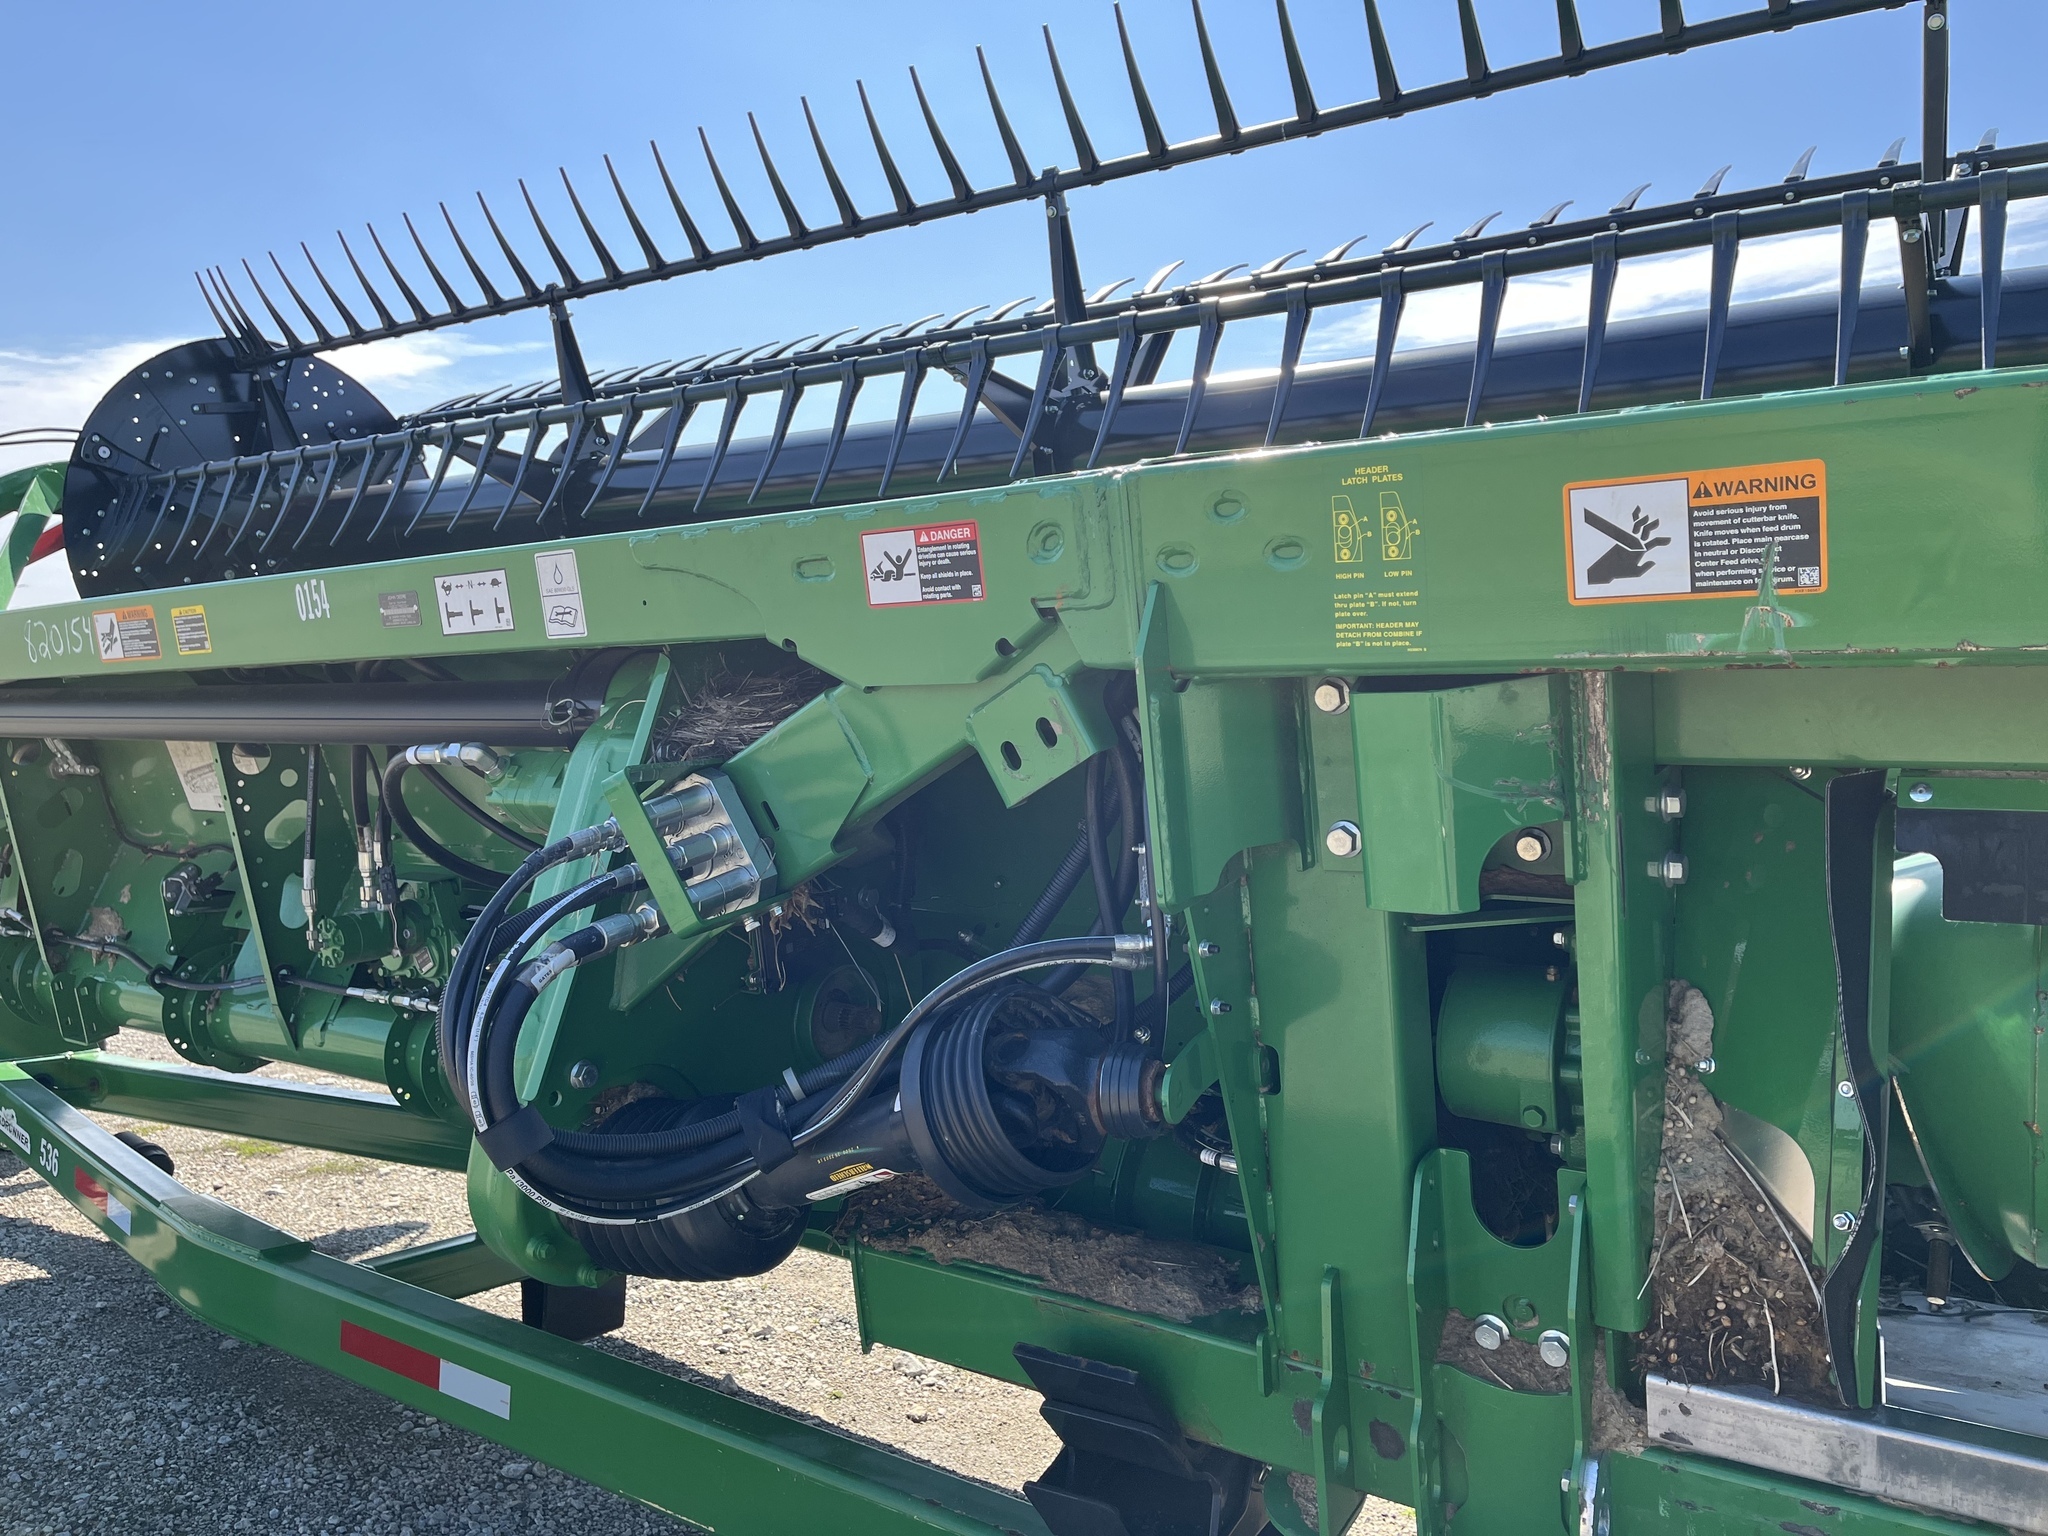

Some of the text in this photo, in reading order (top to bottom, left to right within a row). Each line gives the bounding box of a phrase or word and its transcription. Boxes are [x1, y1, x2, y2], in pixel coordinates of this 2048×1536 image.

[1355, 465, 1388, 475] HEADER
[1342, 474, 1403, 485] LATCH PLATES
[1714, 473, 1816, 497] WARNING
[1745, 506, 1767, 514] injury
[1742, 514, 1776, 523] cutterbar
[930, 528, 971, 541] DANGER
[1774, 534, 1809, 542] gearcase
[917, 545, 946, 553] Entanglement
[1703, 548, 1728, 556] neutral
[1740, 545, 1782, 554] Disconct
[1695, 559, 1719, 567] Center
[1716, 568, 1756, 577] performing
[296, 579, 330, 621] 0154
[127, 608, 148, 618] WARNING
[24, 616, 94, 663] 820154
[40, 1138, 59, 1177] 536
[830, 1163, 874, 1182] WALTERSCHEID
